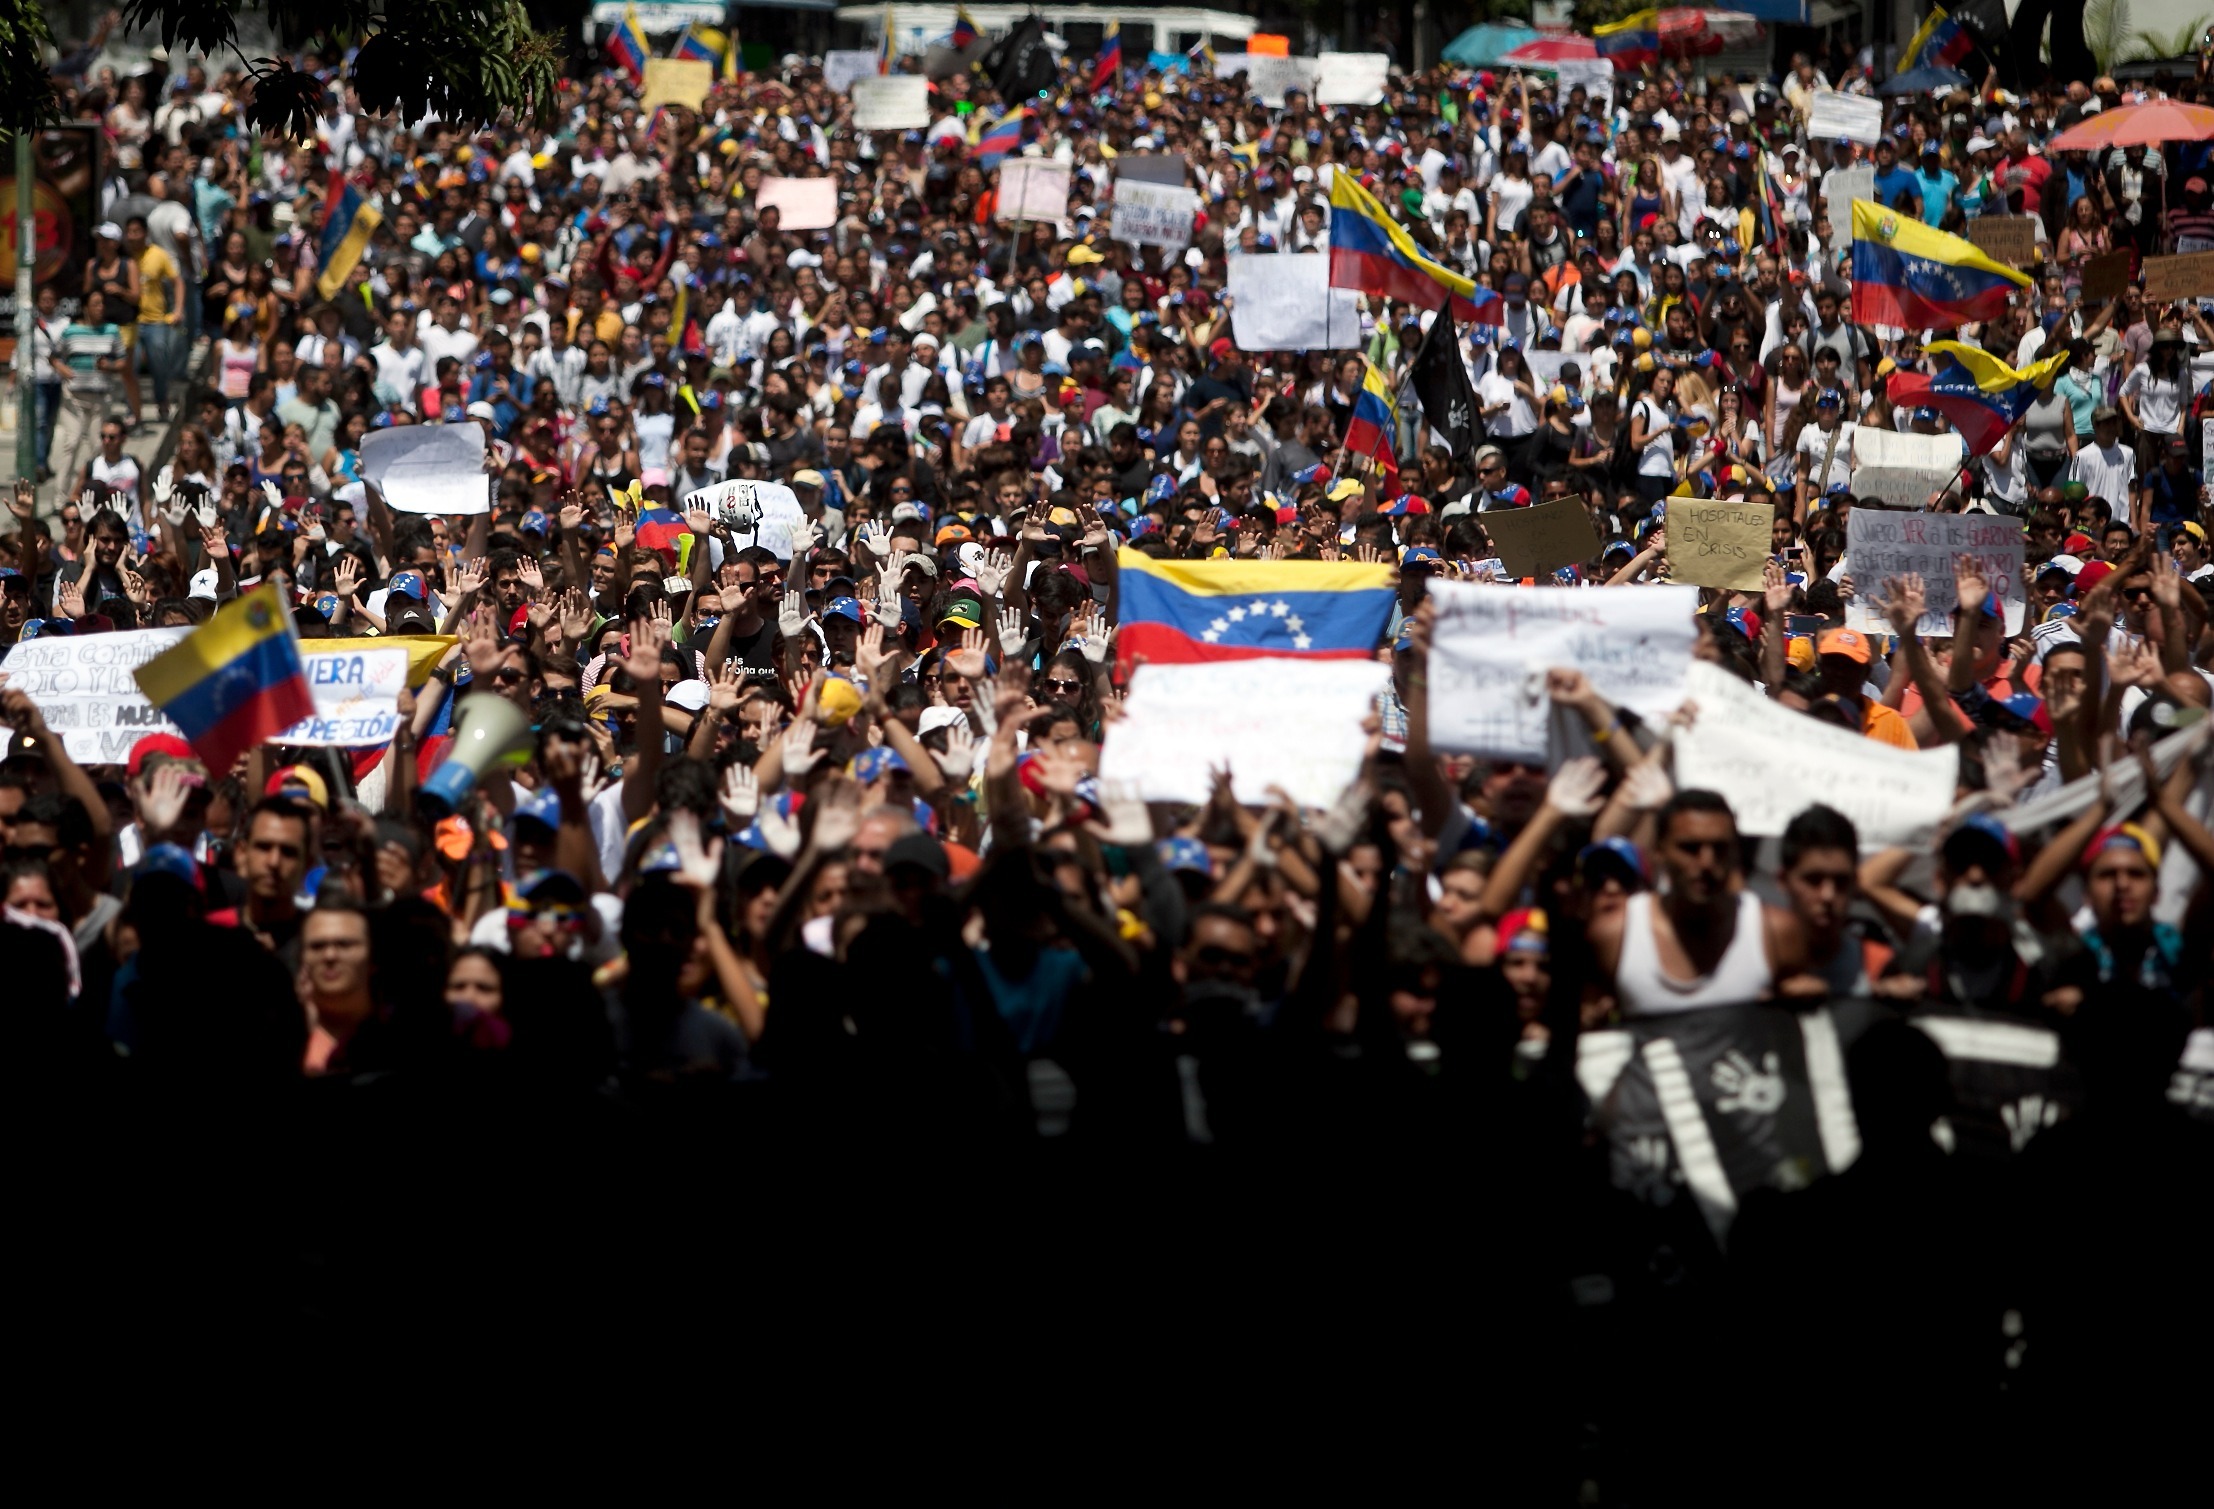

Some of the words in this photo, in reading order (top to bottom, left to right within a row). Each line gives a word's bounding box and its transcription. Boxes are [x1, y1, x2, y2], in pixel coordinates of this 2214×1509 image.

[1689, 508, 1765, 526] HOSPITALES
[1683, 526, 1708, 542] EN
[1901, 518, 1927, 545] VER
[1930, 526, 1941, 546] a
[1698, 542, 1746, 559] CRISIS
[2, 643, 69, 669] Grita
[4, 669, 78, 696] ODIO
[89, 667, 106, 693] Y
[758, 667, 775, 675] out
[278, 709, 397, 740] PRESIÓN
